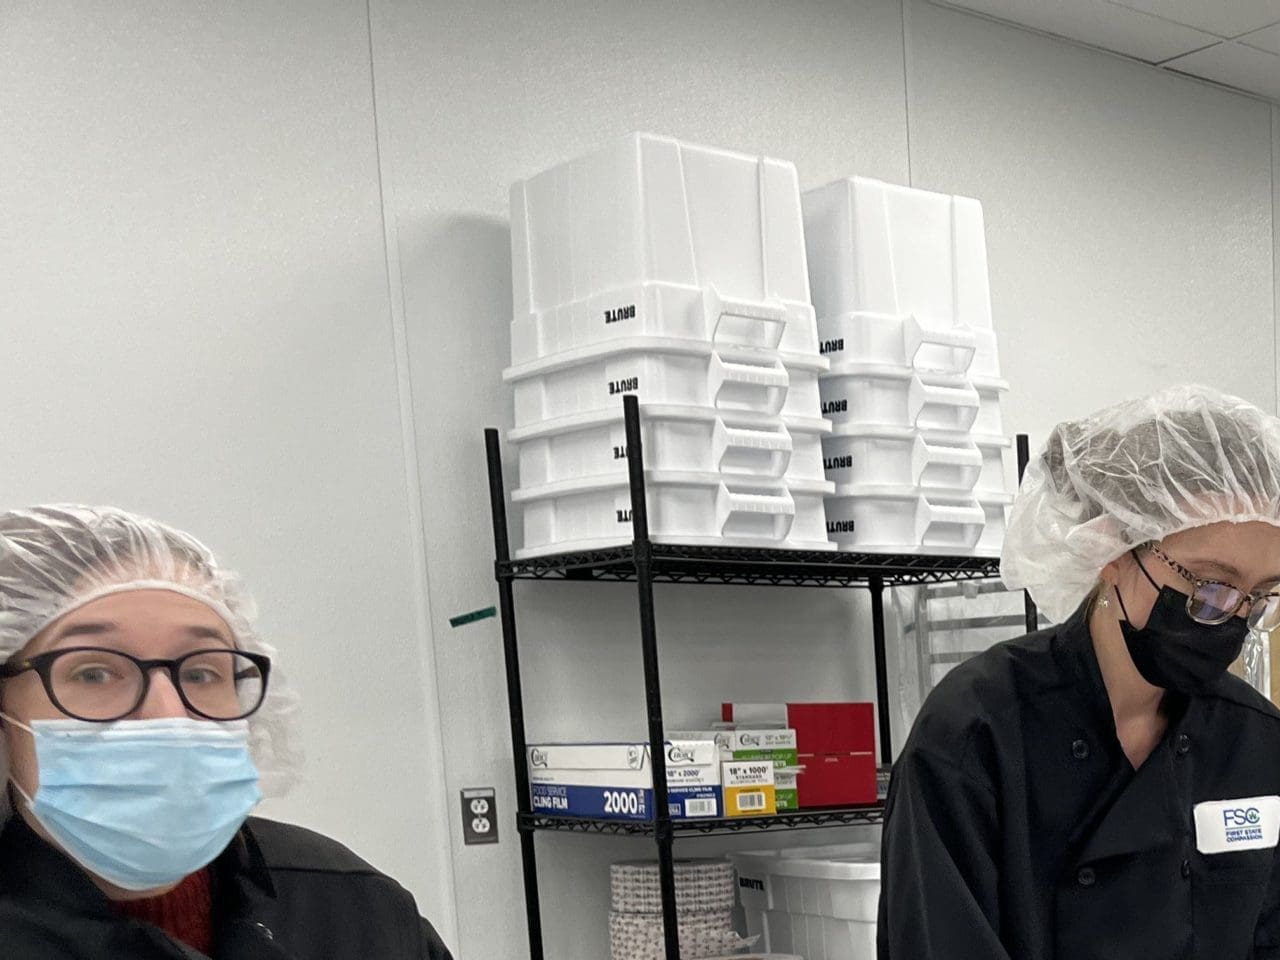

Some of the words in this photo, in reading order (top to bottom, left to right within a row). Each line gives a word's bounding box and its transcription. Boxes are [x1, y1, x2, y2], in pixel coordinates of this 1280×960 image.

[604, 304, 636, 324] BRUTE
[820, 338, 844, 354] BRUT
[608, 377, 638, 395] BRUTE
[822, 399, 848, 415] BRUT
[533, 796, 552, 809] CLING
[552, 797, 568, 810] FILM
[603, 791, 638, 814] 2000
[1223, 807, 1260, 826] FSC
[739, 876, 765, 891] BRUTE
